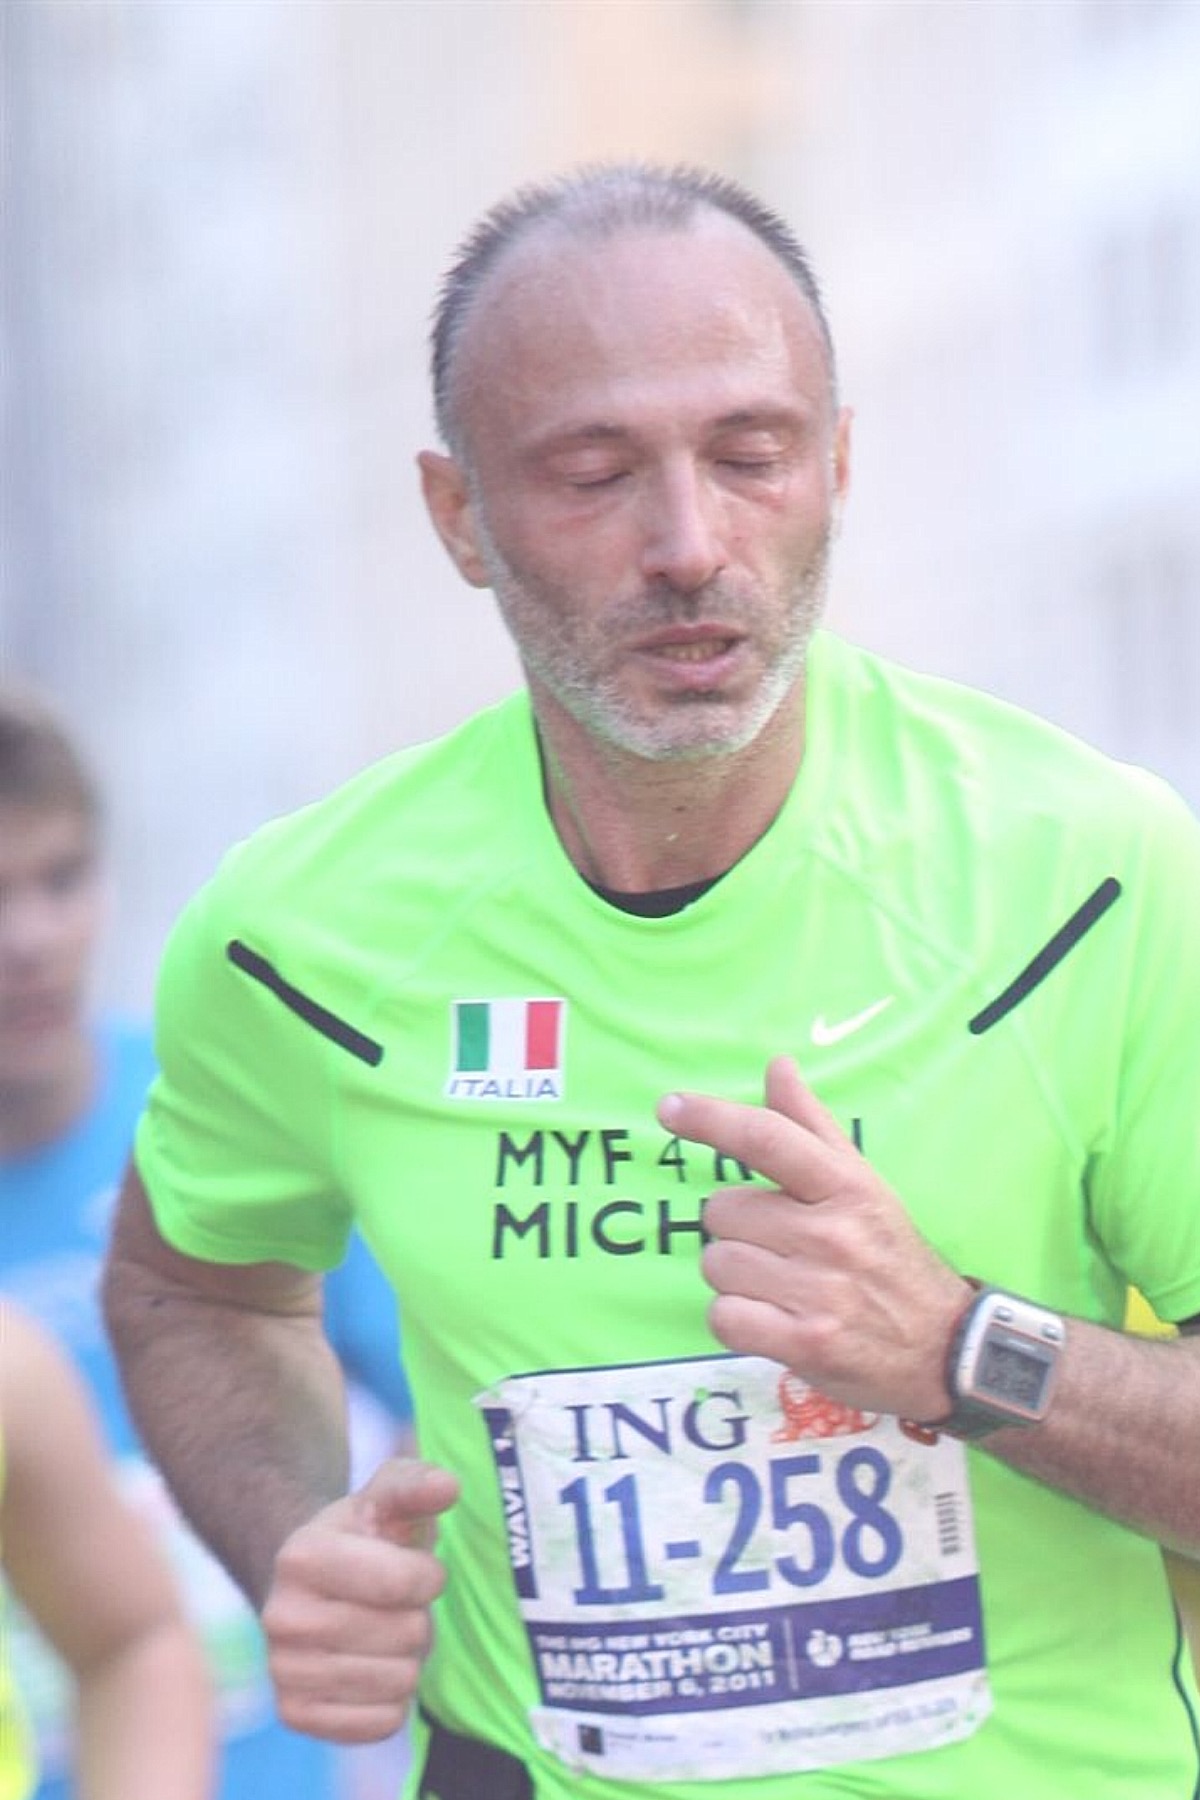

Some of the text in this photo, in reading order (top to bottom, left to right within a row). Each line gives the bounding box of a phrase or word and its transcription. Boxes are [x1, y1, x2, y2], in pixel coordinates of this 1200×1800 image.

[449, 1078, 560, 1098] ITALIA
[496, 1129, 632, 1187] MYF
[658, 1137, 686, 1183] 4
[564, 1389, 753, 1463] ING
[558, 1446, 906, 1606] 11-258
[717, 1623, 769, 1642] CITY
[539, 1640, 775, 1682] MARATHON
[707, 1669, 777, 1695] 2011
